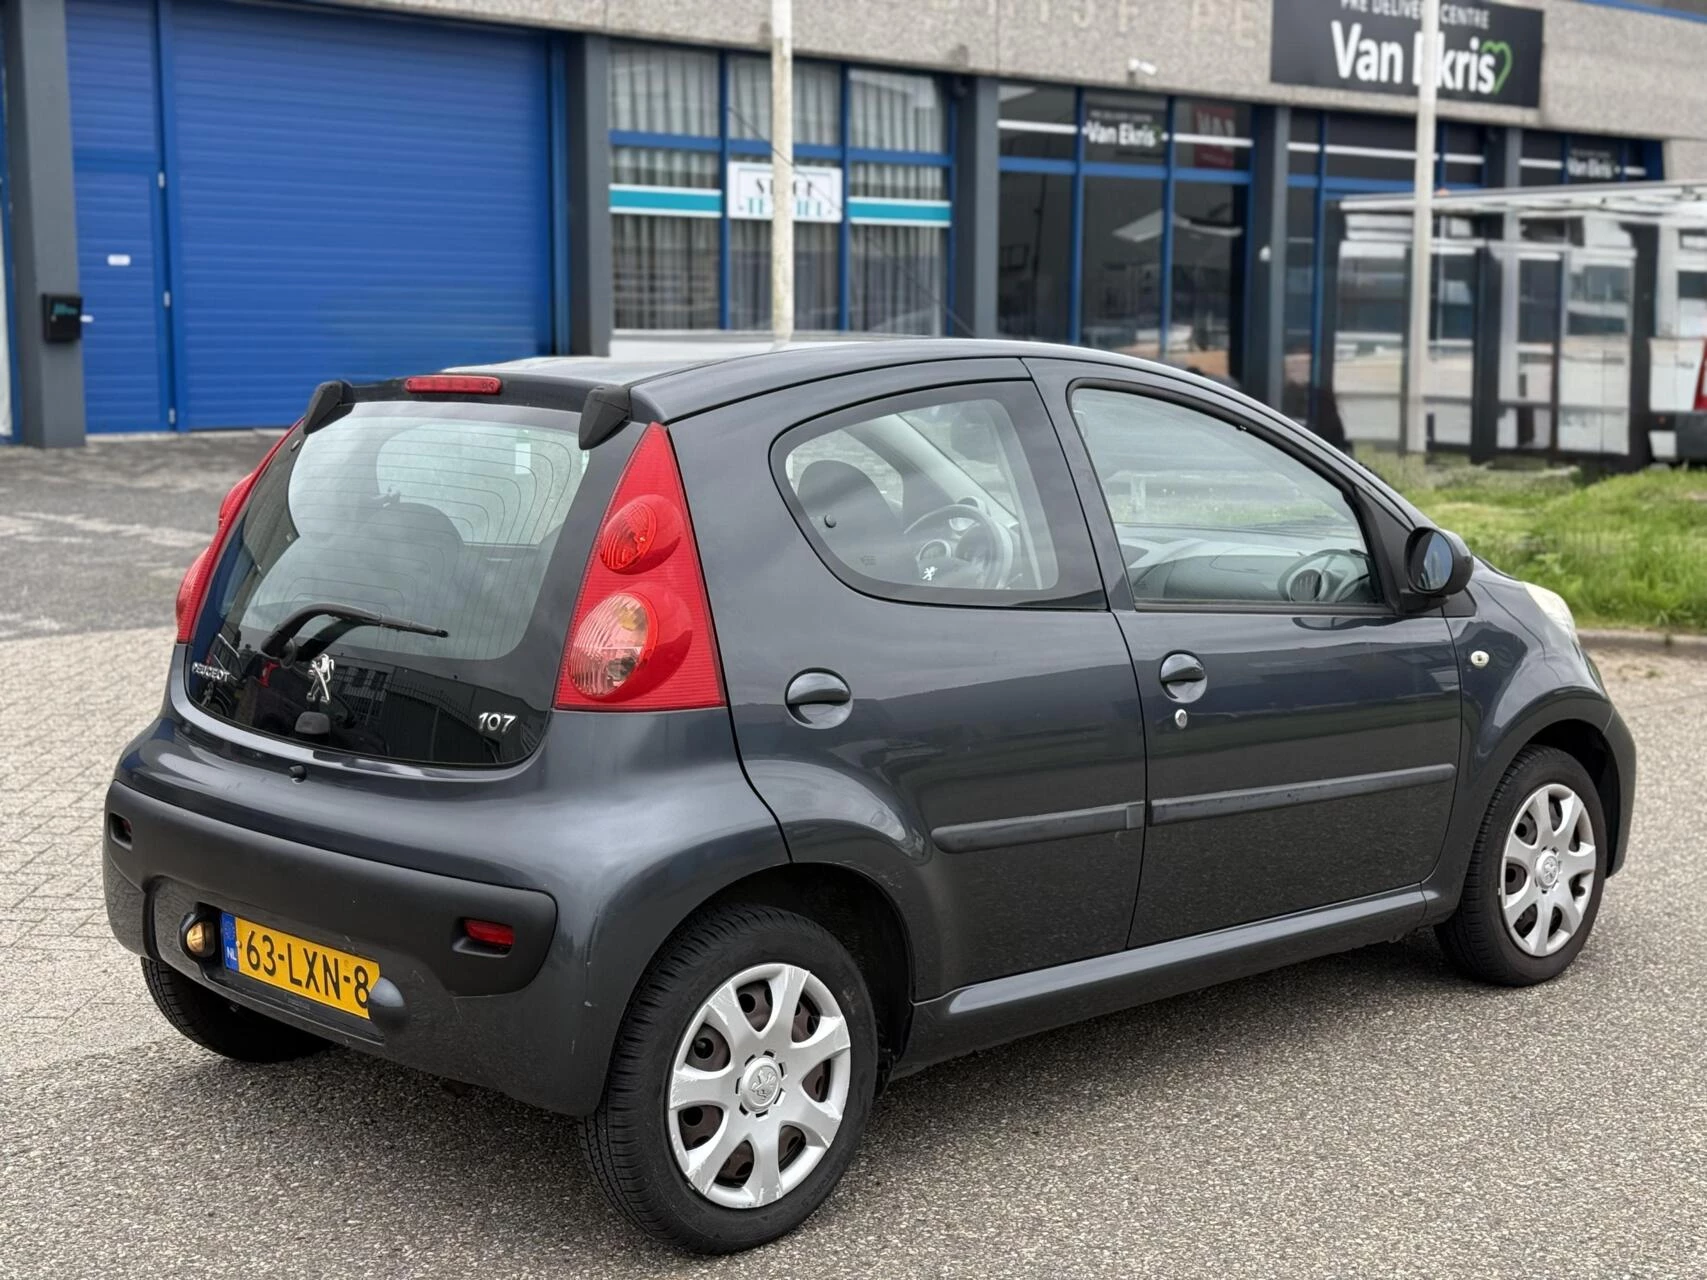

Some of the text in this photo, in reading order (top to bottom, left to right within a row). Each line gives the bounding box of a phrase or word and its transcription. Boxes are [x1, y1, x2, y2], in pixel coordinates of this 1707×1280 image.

[1372, 0, 1422, 20] DELIVE
[1441, 4, 1490, 30] CENTRE
[1331, 20, 1403, 84] Van
[1086, 119, 1157, 148] Van Ekris
[191, 661, 231, 682] PEUGEOT
[479, 712, 516, 733] 107
[246, 930, 369, 1009] 63-LXN-8
